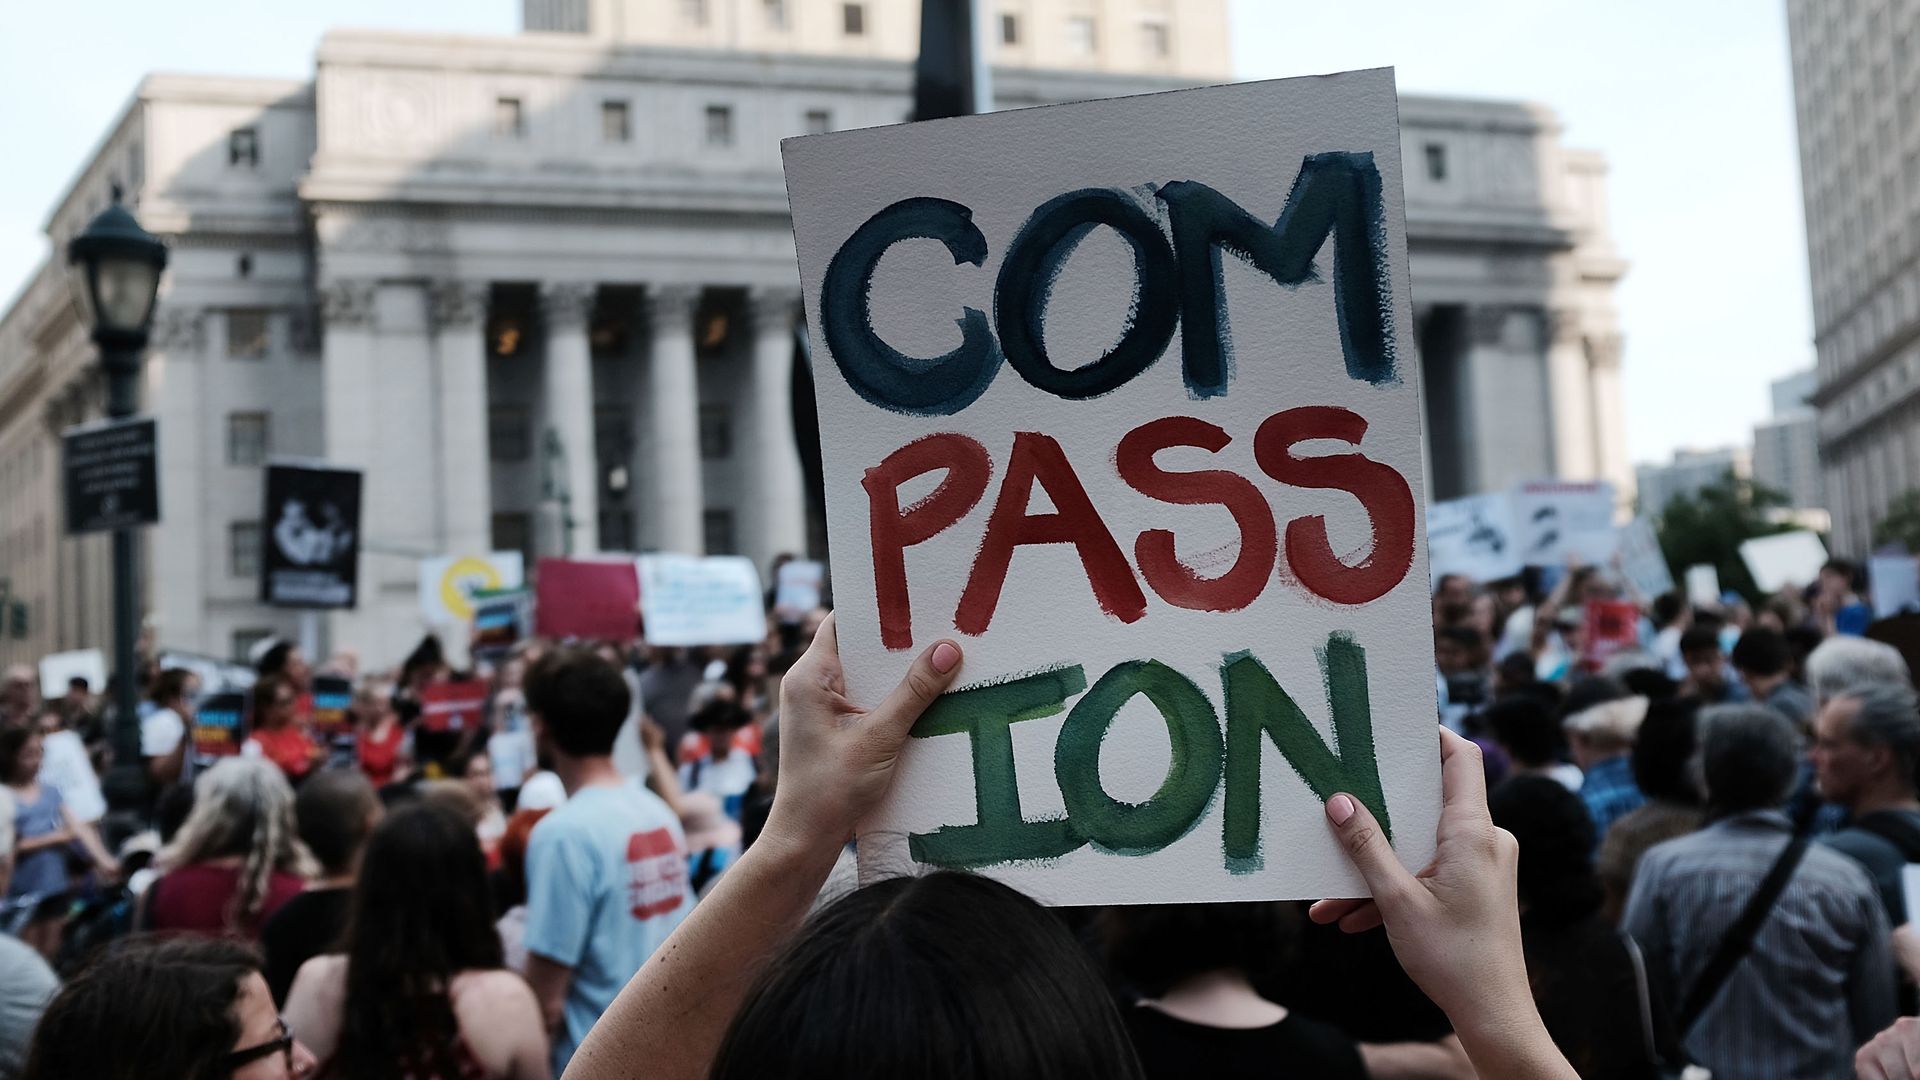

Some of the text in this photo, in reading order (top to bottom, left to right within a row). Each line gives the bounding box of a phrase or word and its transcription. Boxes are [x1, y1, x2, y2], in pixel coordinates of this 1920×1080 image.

[820, 151, 1402, 416] COM
[861, 405, 1415, 650] PASS
[908, 630, 1394, 875] ION
